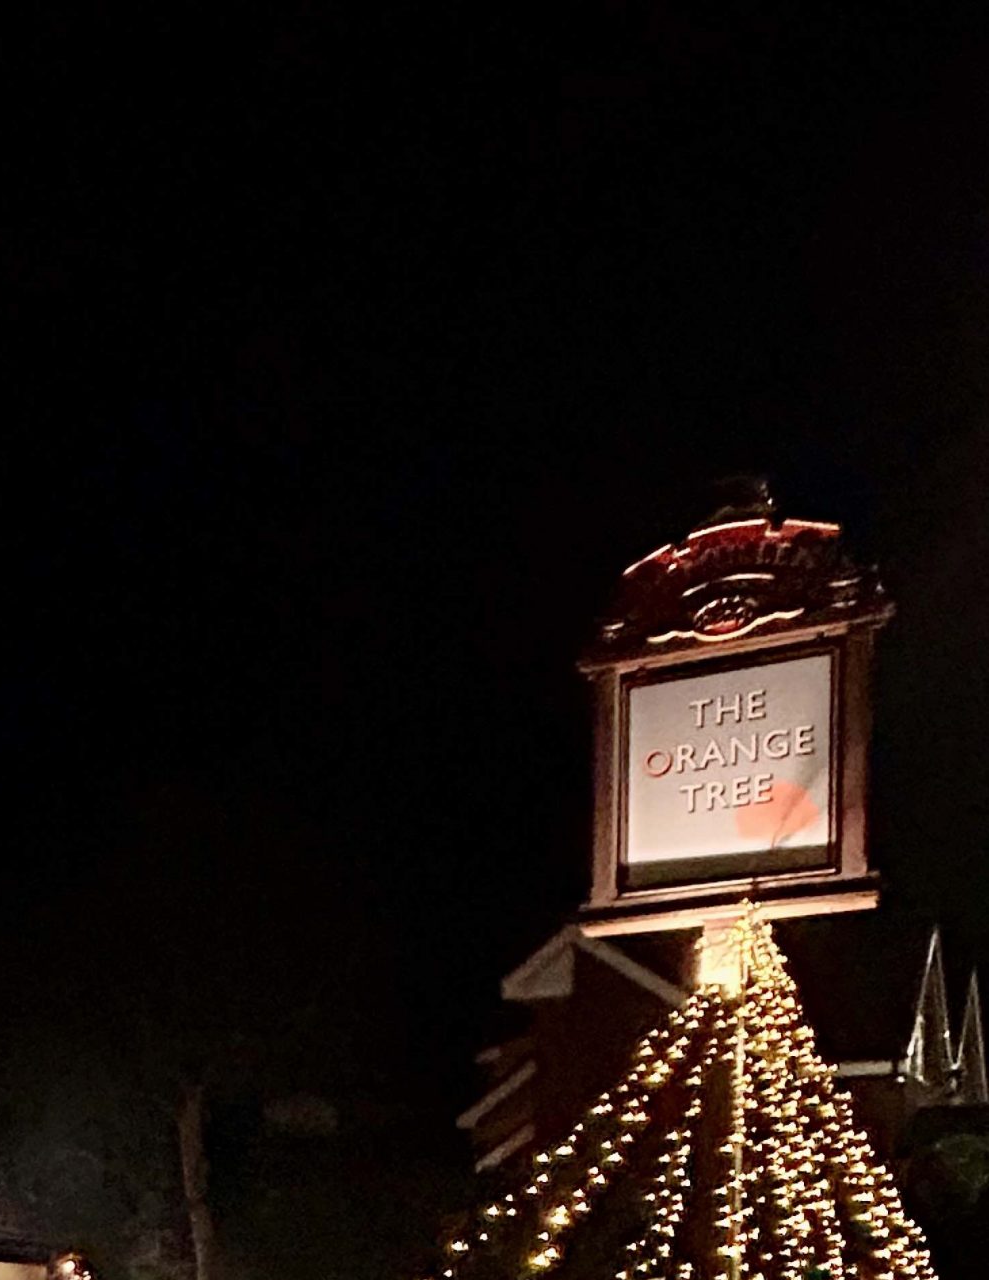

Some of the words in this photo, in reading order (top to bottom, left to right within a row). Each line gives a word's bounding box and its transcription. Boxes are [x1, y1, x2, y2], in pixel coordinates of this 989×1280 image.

[690, 690, 767, 728] THE
[644, 725, 815, 778] ORANGE
[679, 773, 774, 813] TREE
